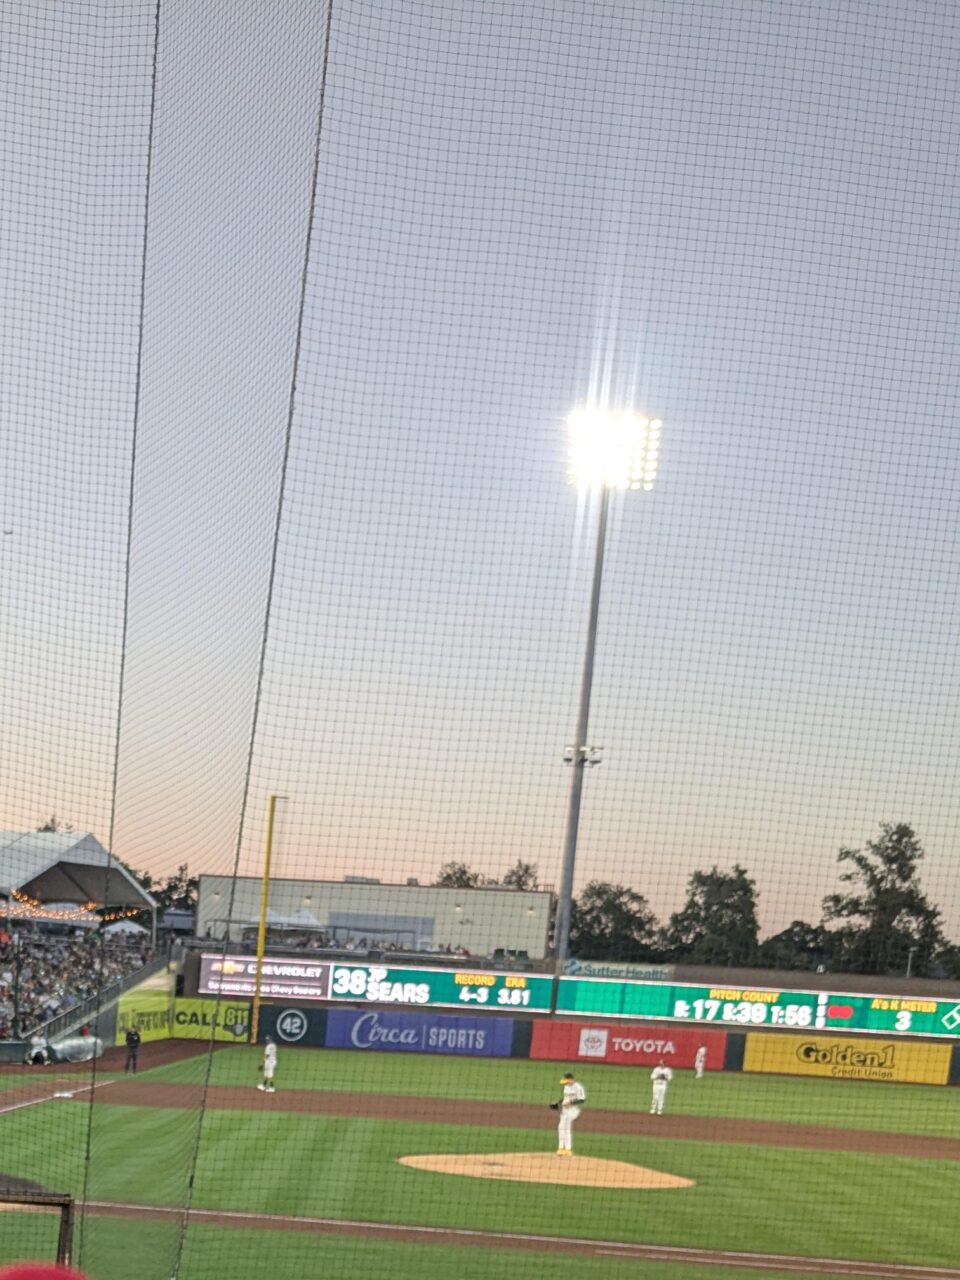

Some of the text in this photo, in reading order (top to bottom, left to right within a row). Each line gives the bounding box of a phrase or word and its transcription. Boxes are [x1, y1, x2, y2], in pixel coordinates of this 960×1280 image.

[367, 967, 388, 983] JP
[583, 962, 670, 980] Sutter Health
[333, 968, 367, 995] 38
[454, 973, 527, 989] RECORD ERA
[366, 982, 430, 1004] SEARS
[458, 986, 489, 1004] 4-3
[709, 988, 780, 1004] PITCH COUNT
[692, 998, 722, 1021] 17
[901, 1001, 938, 1014] METER
[175, 1011, 221, 1028] CALL
[281, 1016, 302, 1034] 42
[894, 1010, 913, 1032] 3
[350, 1012, 488, 1049] Circa SPORTS
[611, 1037, 676, 1055] TOYOTA
[831, 1066, 894, 1079] Credit Union
